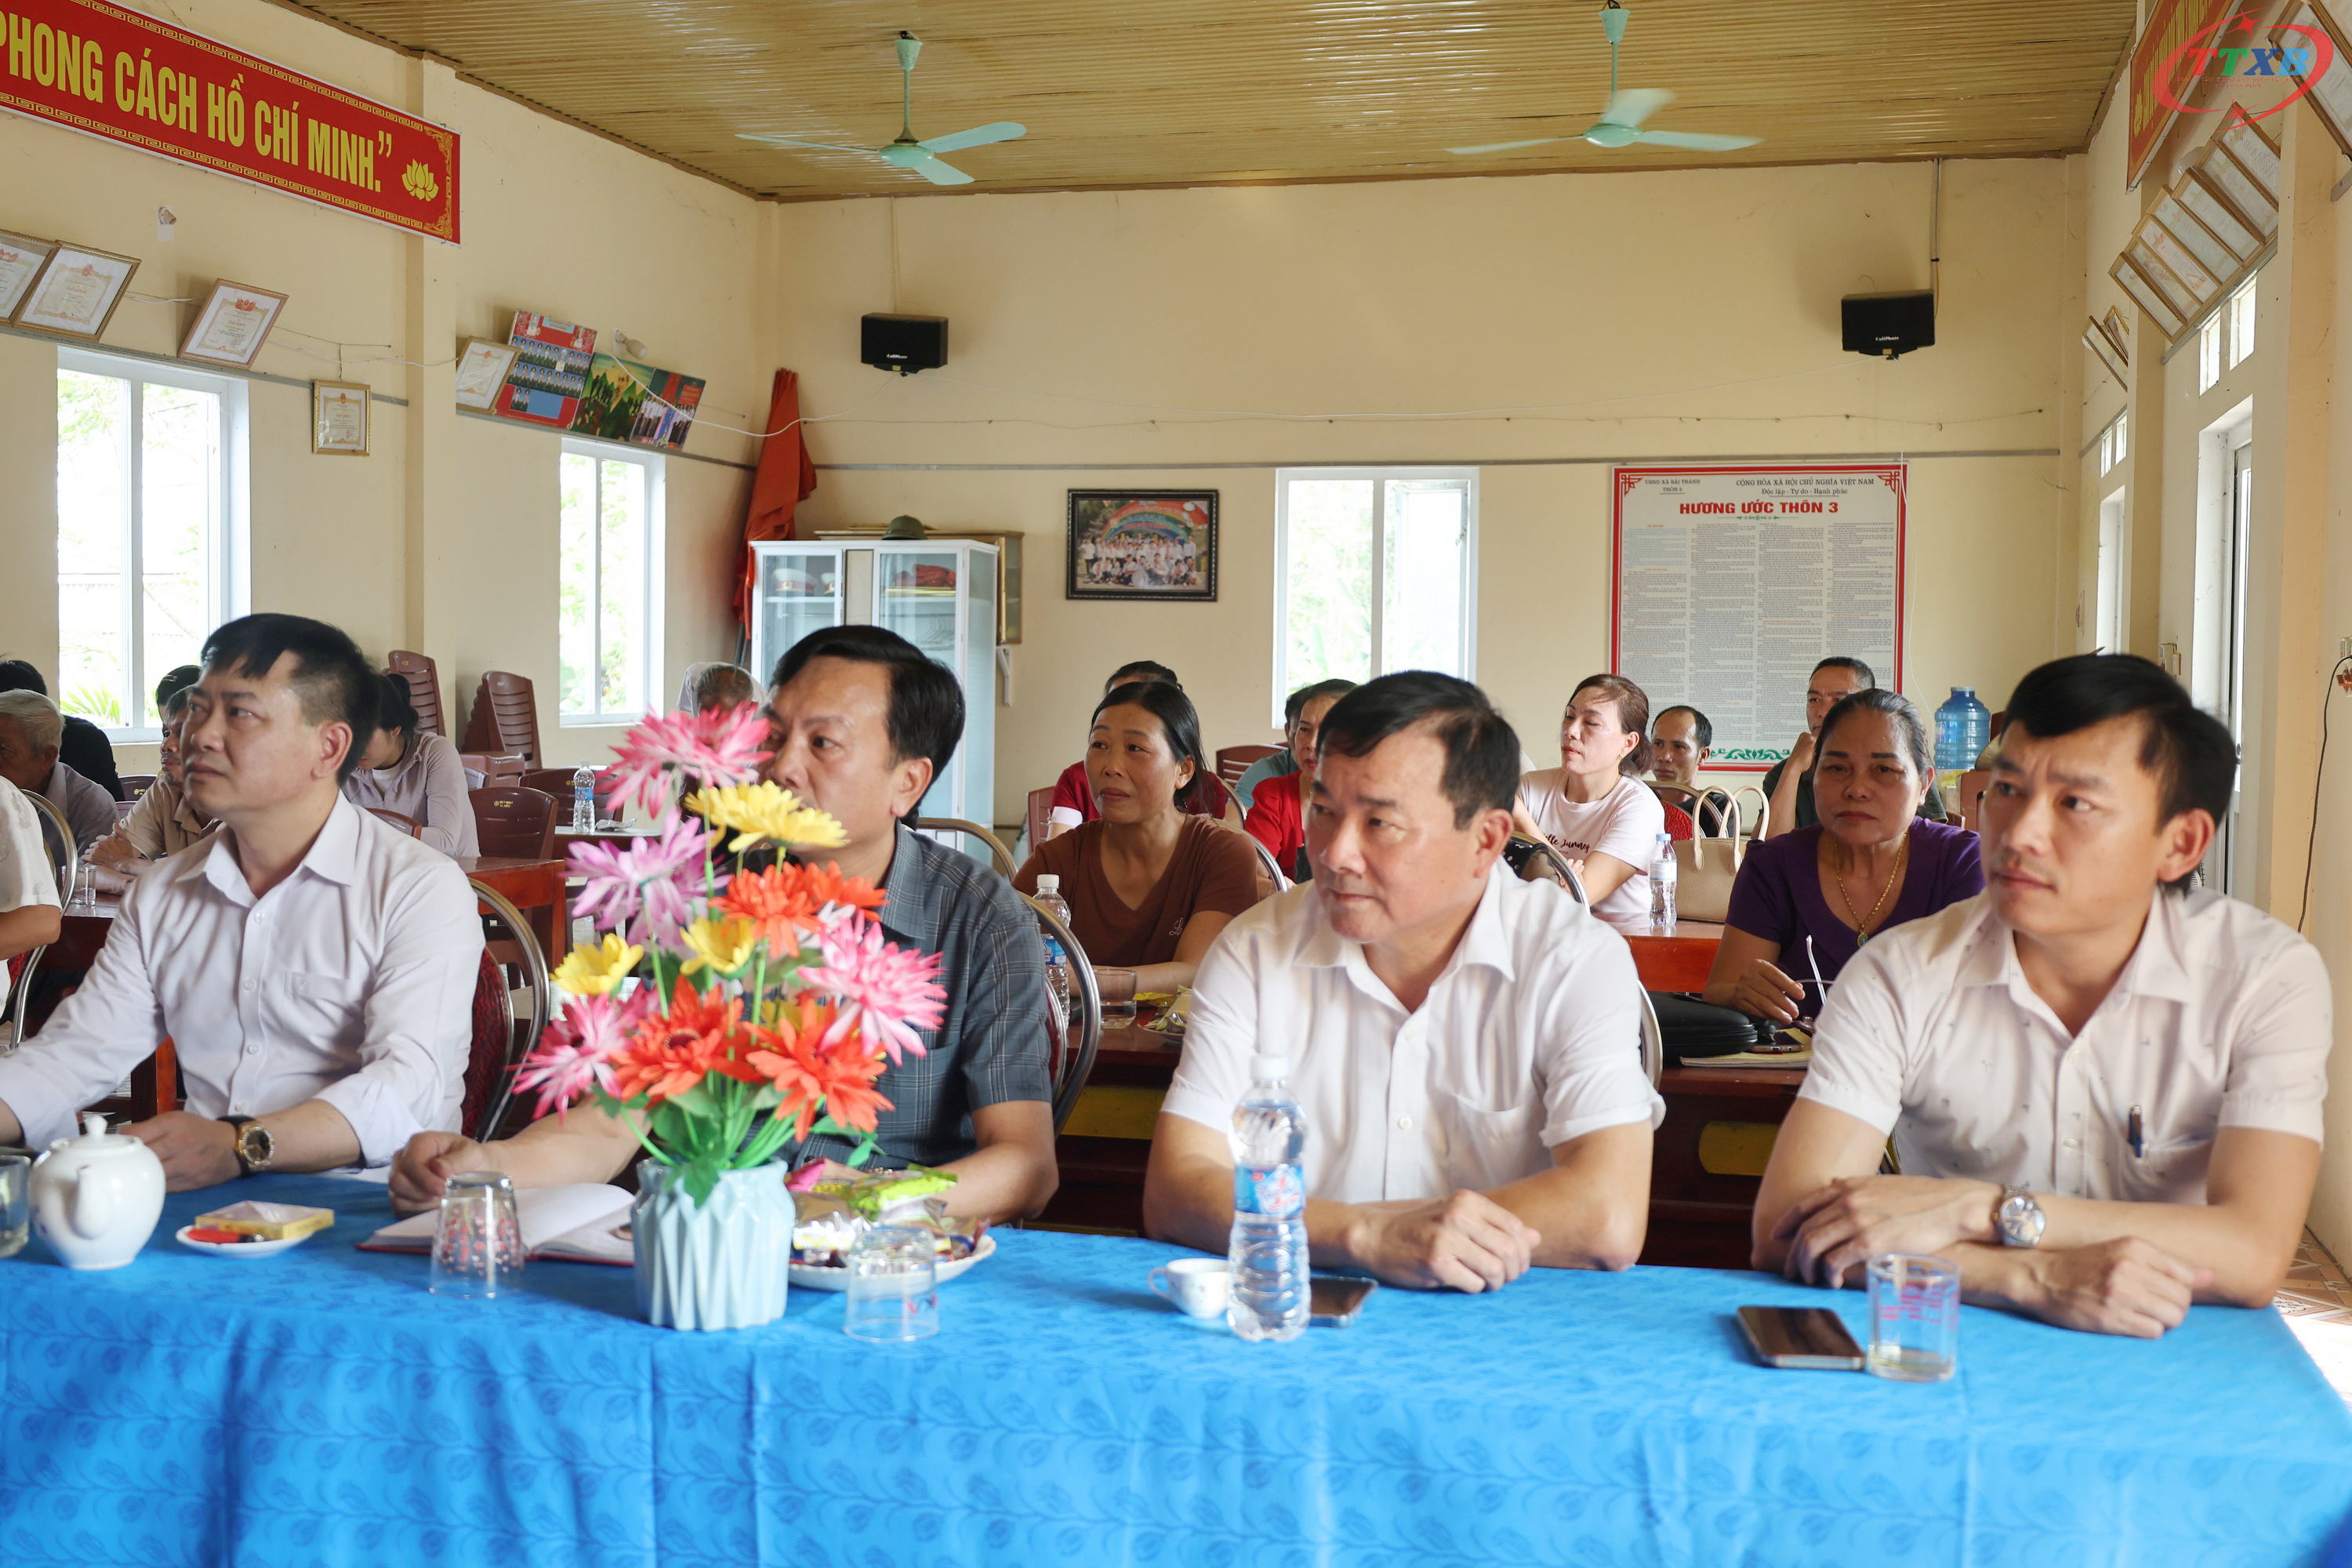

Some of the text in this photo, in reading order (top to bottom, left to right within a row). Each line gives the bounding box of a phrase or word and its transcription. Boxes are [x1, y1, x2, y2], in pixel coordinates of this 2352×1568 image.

[115, 48, 198, 133] CÁCH
[208, 73, 245, 147] HỒ
[255, 100, 299, 166] CHÍ
[1736, 478, 1755, 487] CỘNG
[1784, 477, 1798, 486] HỘI
[1799, 477, 1813, 485] CHỦ
[1839, 477, 1857, 485] VIỆT
[1679, 499, 1838, 514] HƯƠNG ƯỚC THÔN 3
